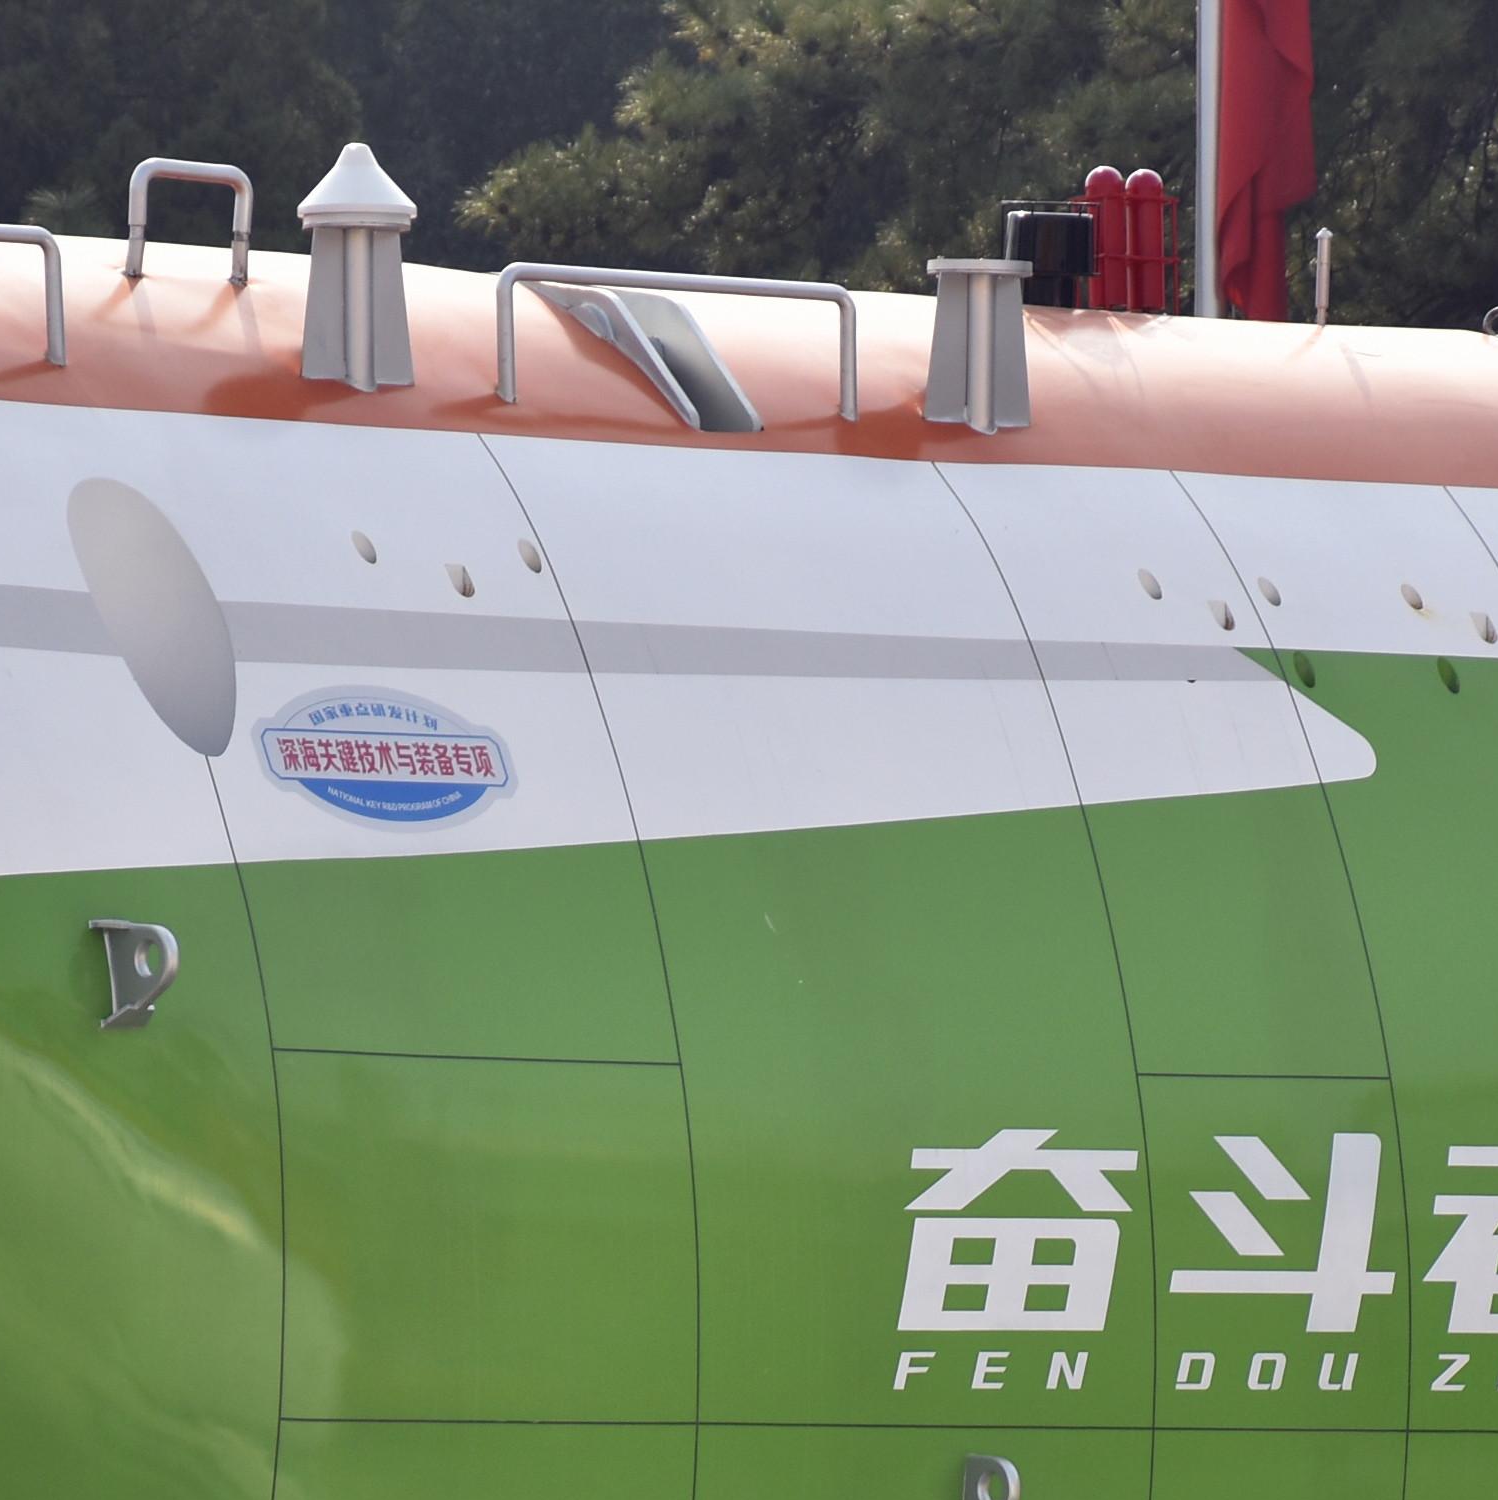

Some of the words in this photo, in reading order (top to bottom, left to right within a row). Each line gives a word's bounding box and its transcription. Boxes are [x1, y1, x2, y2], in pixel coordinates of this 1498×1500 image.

[278, 737, 495, 777] 深海关键技术与装备专项
[327, 785, 365, 807] NATIONAL
[366, 800, 381, 809] KEY
[893, 1351, 1089, 1391] FEN
[1175, 1352, 1360, 1391] DOU
